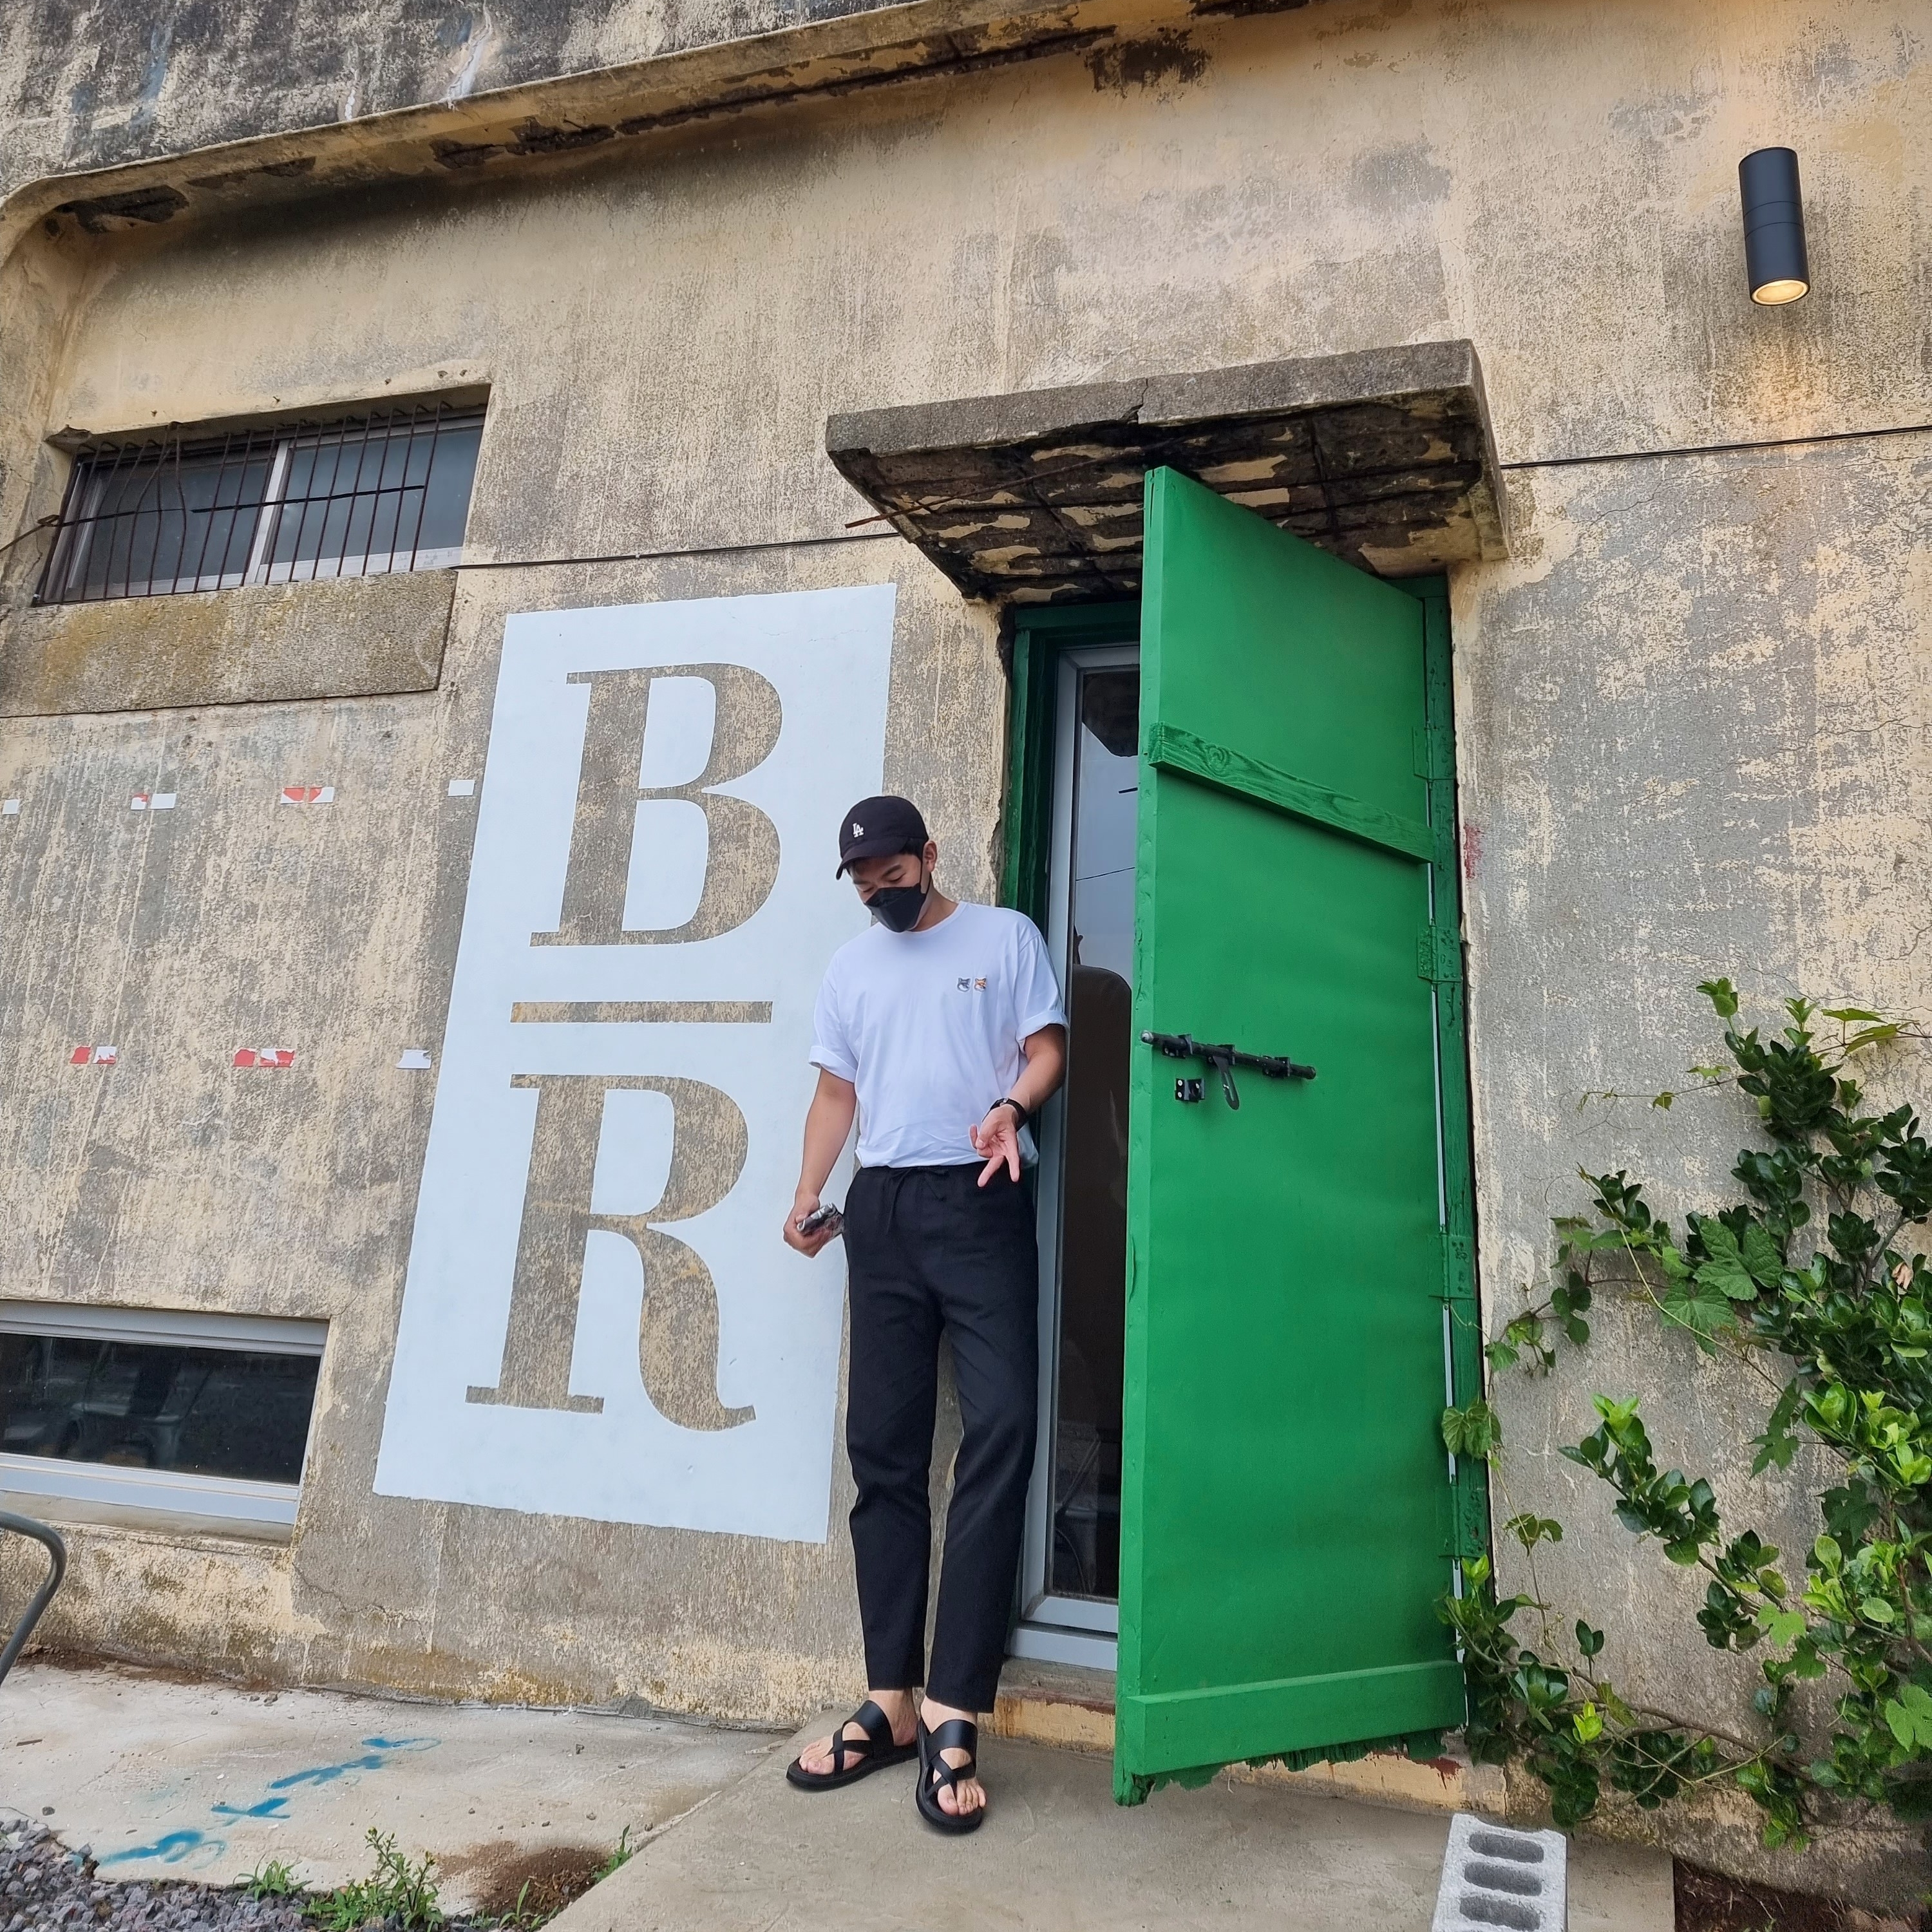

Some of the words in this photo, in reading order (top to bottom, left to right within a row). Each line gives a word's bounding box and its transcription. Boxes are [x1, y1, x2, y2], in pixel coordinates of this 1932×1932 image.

[529, 663, 782, 947] B
[853, 822, 864, 838] LA
[465, 1074, 756, 1431] R
